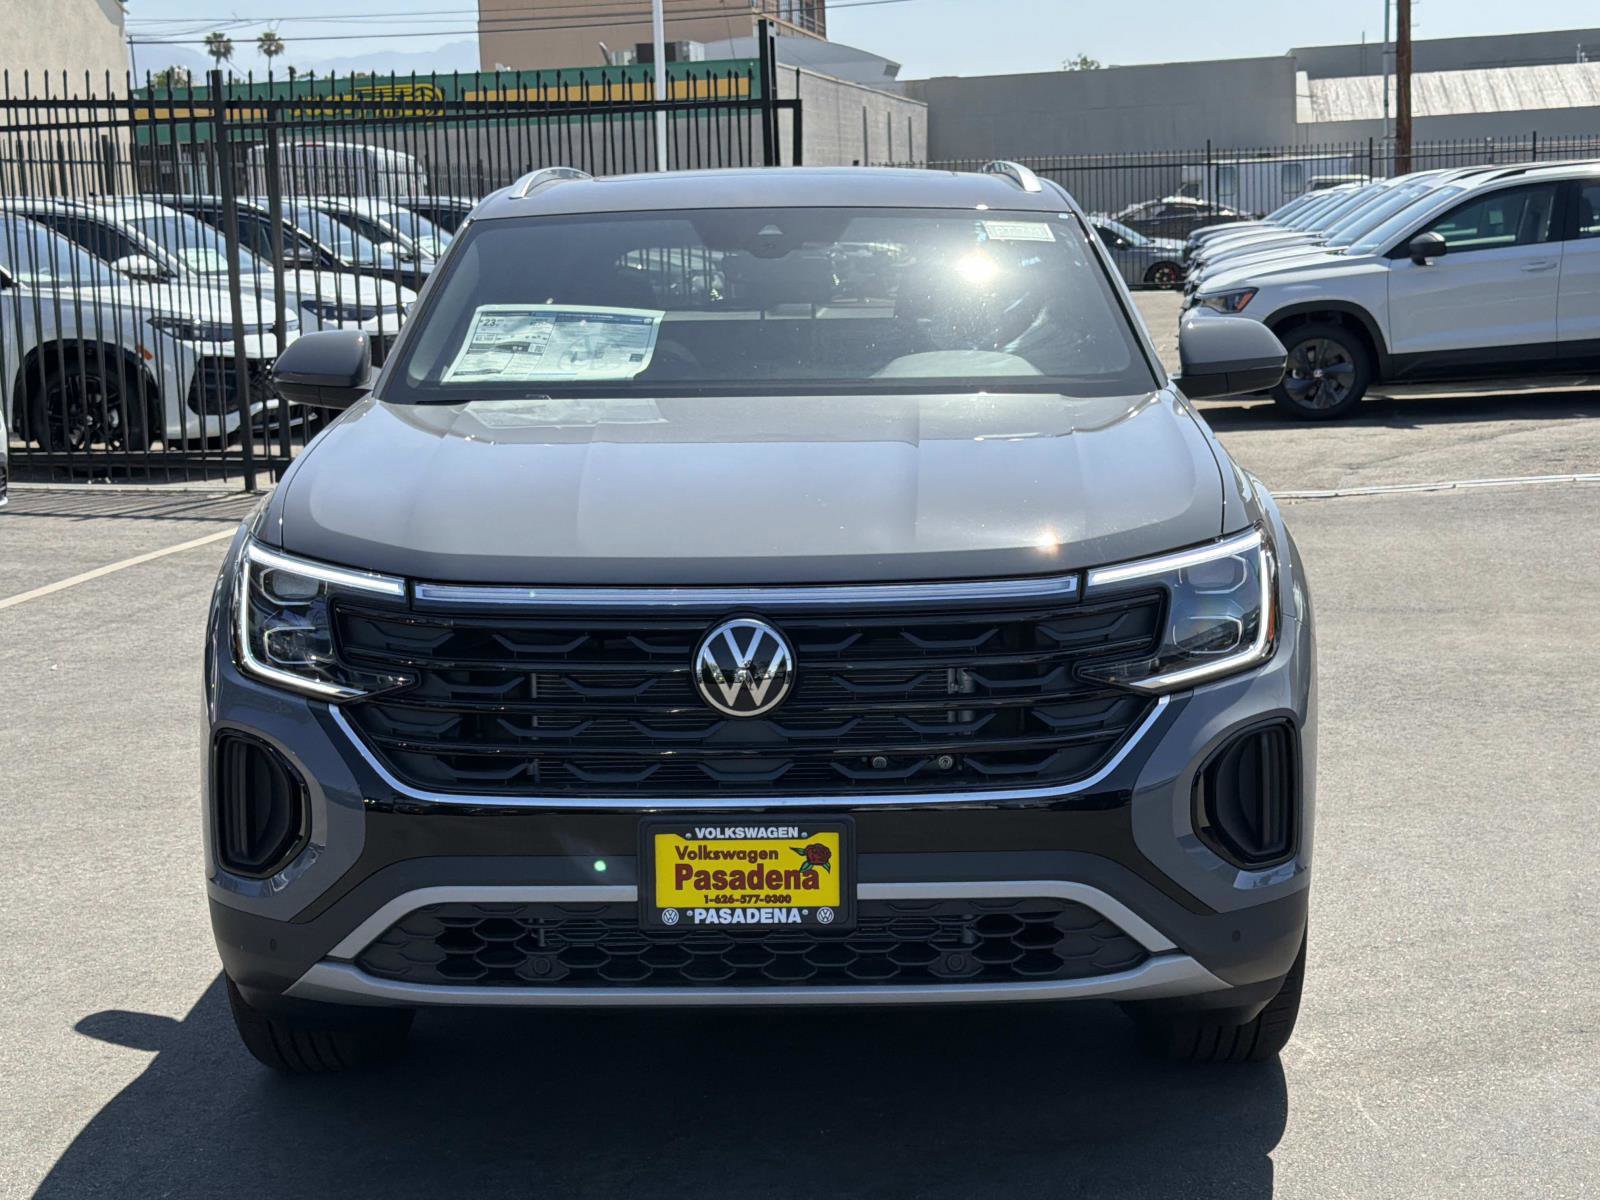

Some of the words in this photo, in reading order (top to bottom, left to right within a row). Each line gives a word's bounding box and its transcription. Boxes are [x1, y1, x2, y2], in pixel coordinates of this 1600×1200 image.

[699, 621, 789, 713] VW
[695, 827, 799, 839] VOLKSWAGEN
[675, 845, 779, 864] Volkswagen
[675, 863, 820, 891] Pasadena
[704, 894, 792, 904] 1-626-577-0300
[694, 908, 803, 924] PASADENA
